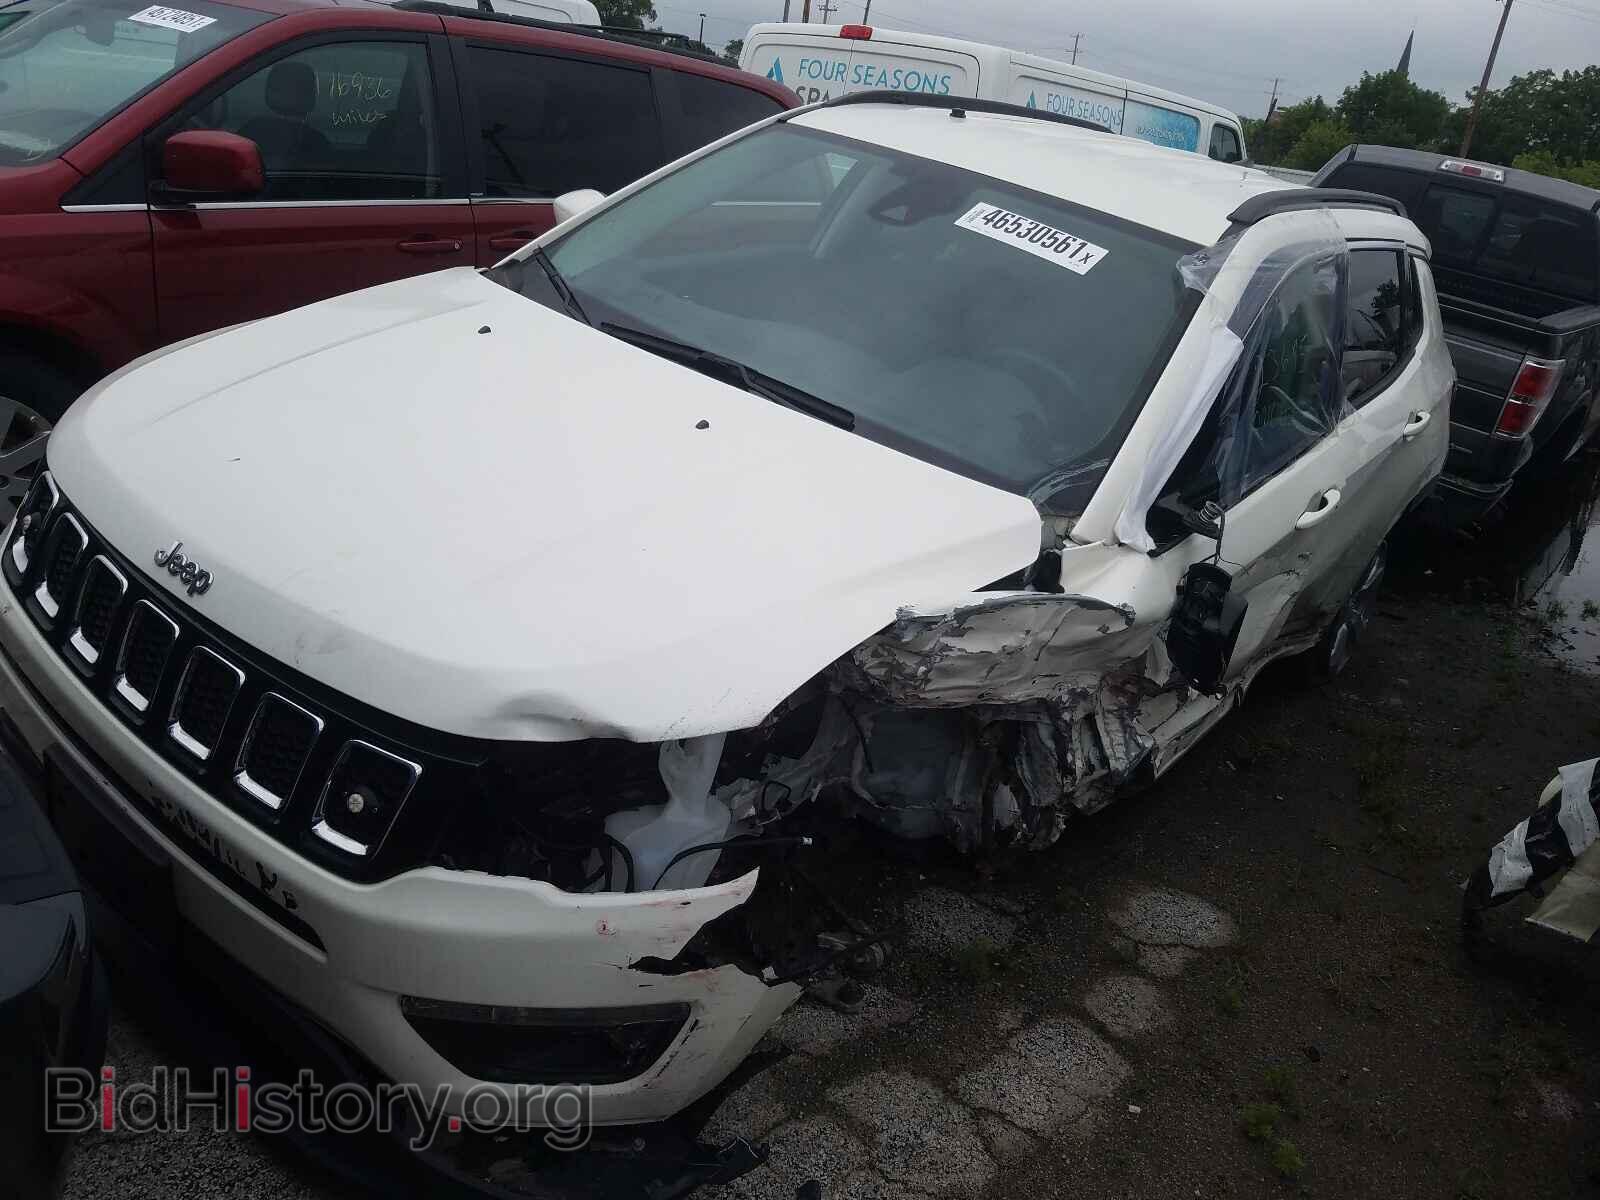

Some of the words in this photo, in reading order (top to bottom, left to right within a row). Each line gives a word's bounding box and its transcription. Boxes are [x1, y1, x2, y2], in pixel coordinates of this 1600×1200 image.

[798, 58, 847, 82] FOUR
[851, 64, 951, 95] SEASONS
[1046, 93, 1075, 117] FOUR
[1075, 101, 1123, 129] SEASONS
[153, 541, 214, 597] Jeep
